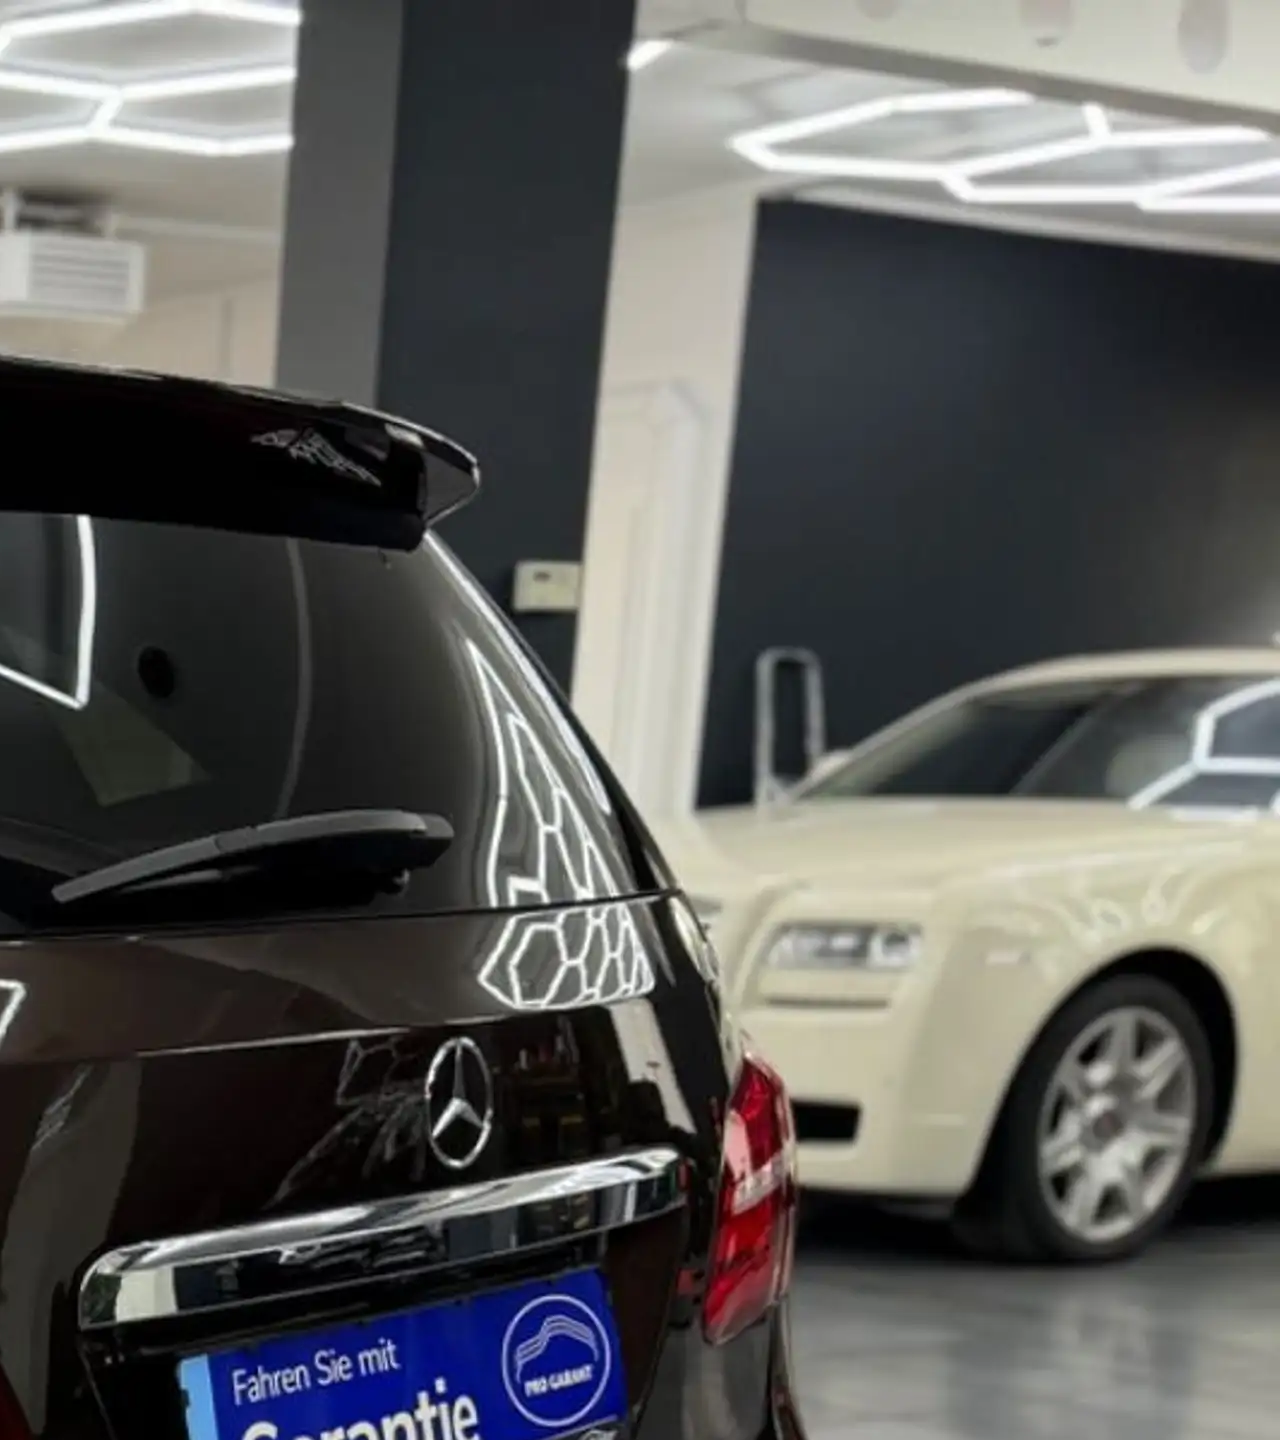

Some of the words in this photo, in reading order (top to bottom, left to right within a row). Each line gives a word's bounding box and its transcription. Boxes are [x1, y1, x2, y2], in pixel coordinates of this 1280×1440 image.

[232, 1364, 311, 1406] Fahren
[314, 1349, 354, 1386] Sie
[358, 1337, 402, 1377] mit
